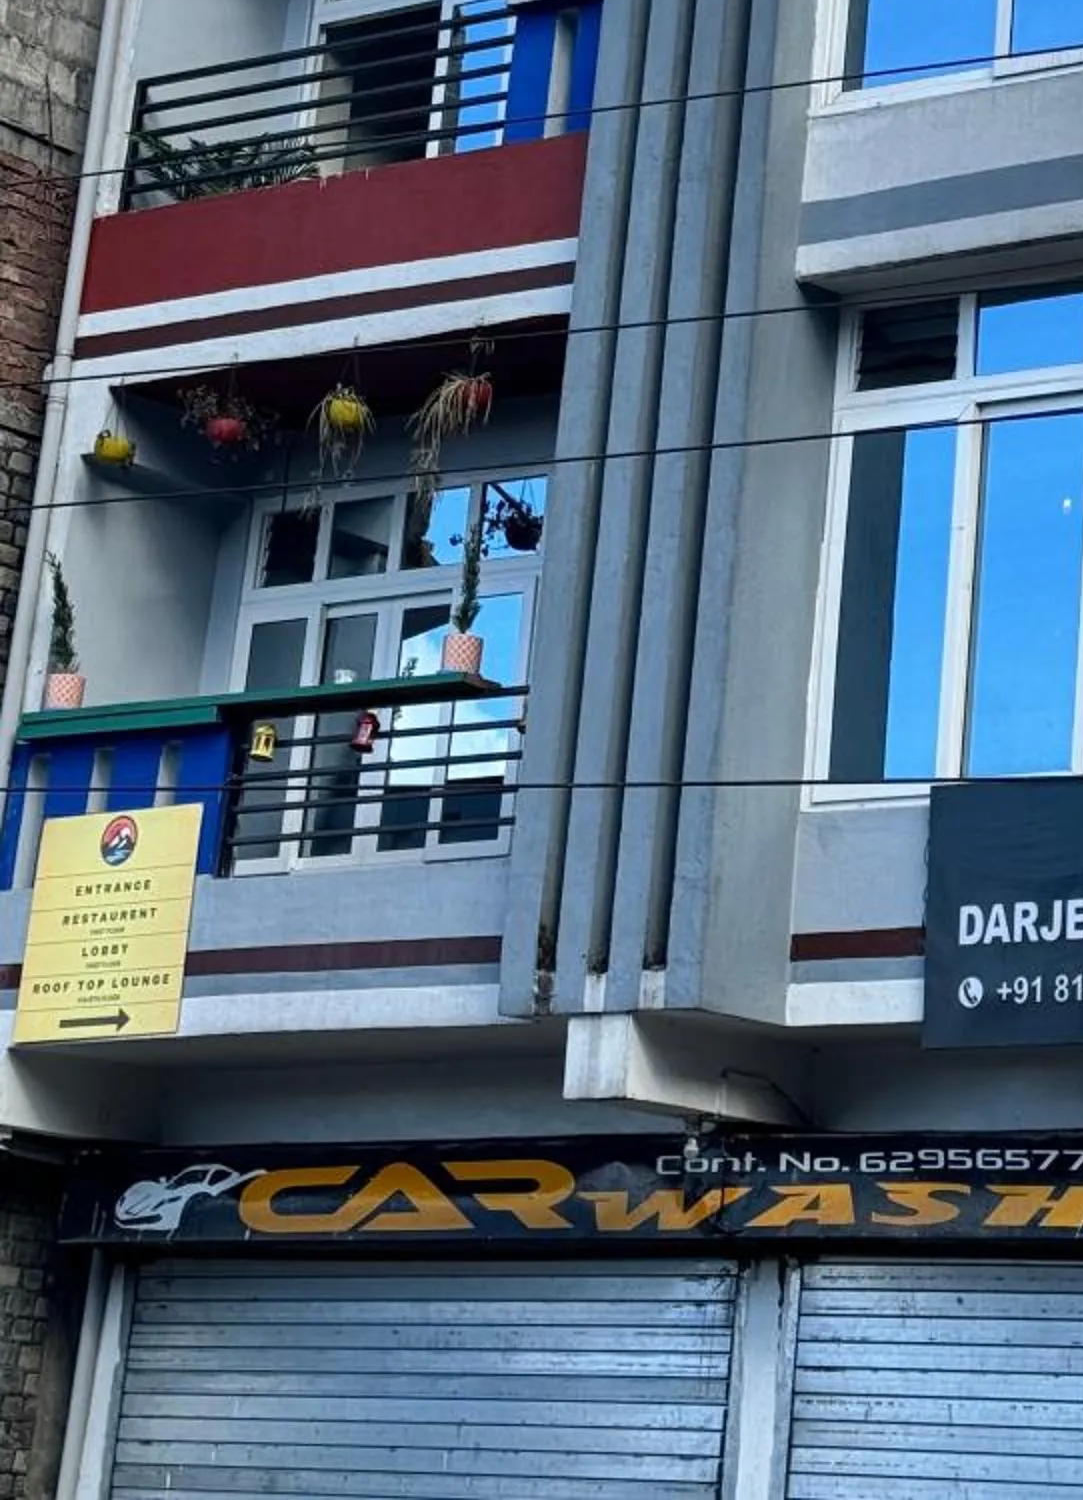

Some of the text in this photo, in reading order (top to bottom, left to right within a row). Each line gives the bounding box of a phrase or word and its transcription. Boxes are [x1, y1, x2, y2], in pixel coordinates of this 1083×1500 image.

[75, 880, 151, 896] ENTRANCE
[63, 908, 157, 925] RESTAURENT
[82, 945, 129, 956] LOBBY
[33, 974, 170, 993] ROOF TOP LOUNGE
[996, 975, 1043, 1005] +91
[655, 1153, 766, 1175] Cont.
[777, 1151, 851, 1174] No.
